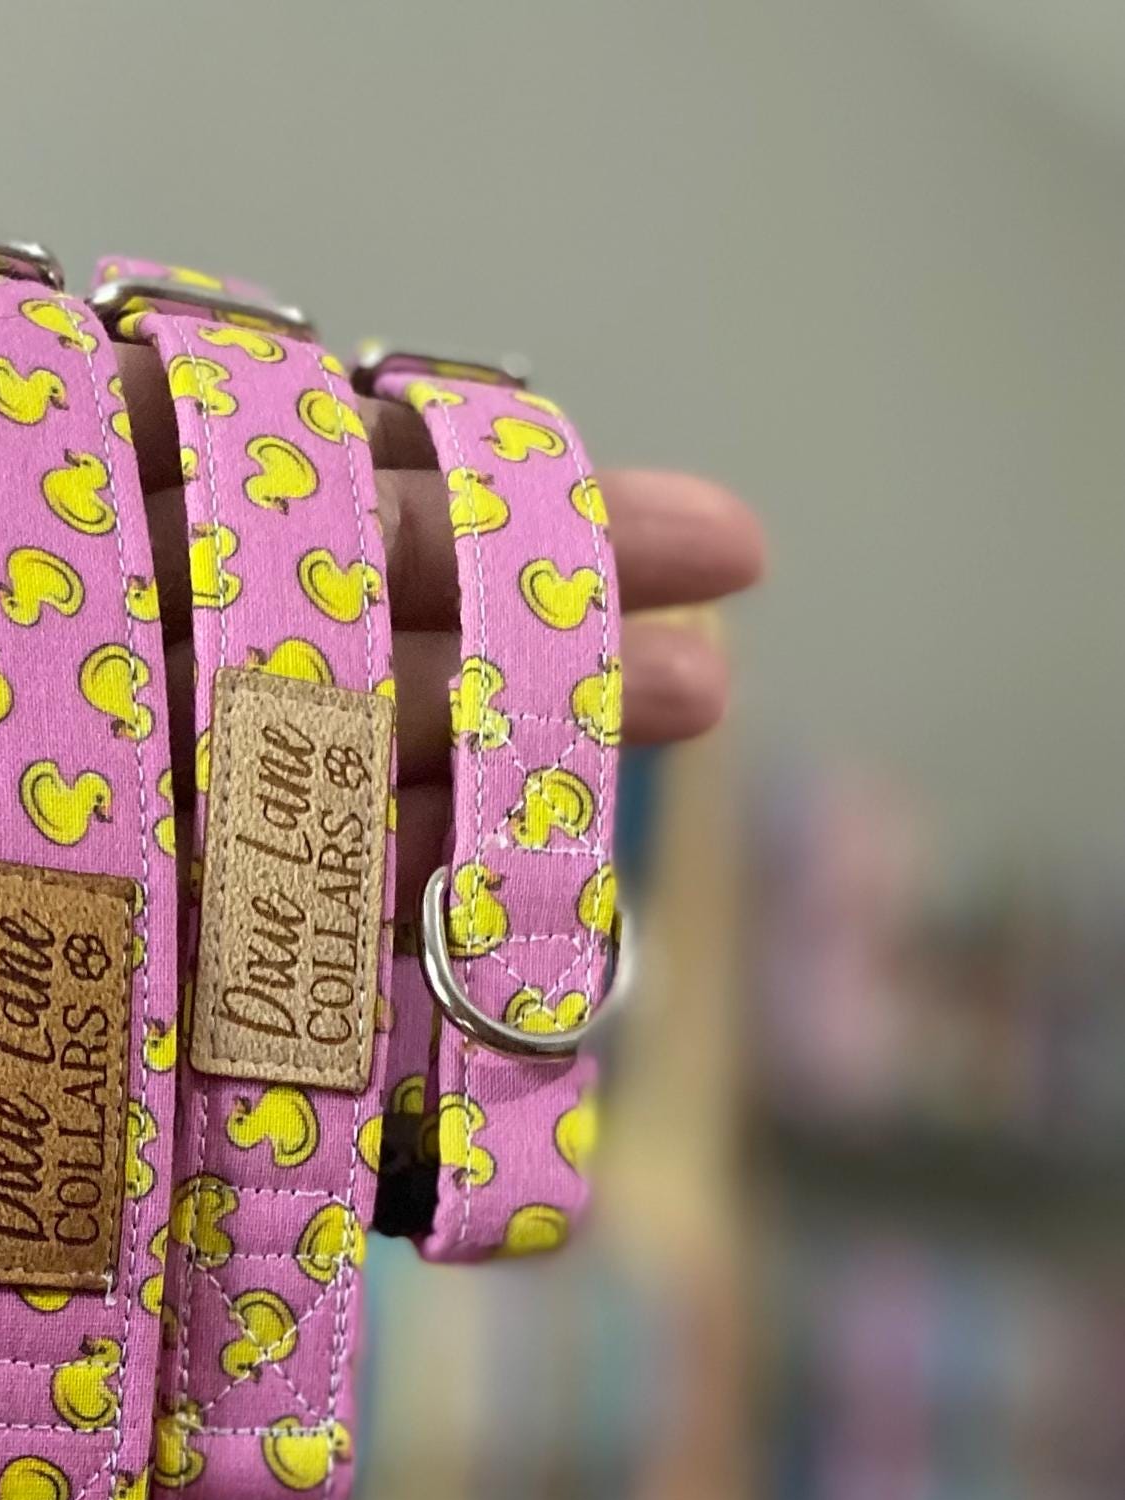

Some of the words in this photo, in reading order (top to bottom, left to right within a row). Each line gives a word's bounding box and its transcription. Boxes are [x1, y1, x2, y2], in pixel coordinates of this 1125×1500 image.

[235, 717, 316, 867] Lane
[218, 891, 306, 1040] Dixie
[306, 810, 365, 1046] COLLARS
[53, 1003, 110, 1247] COLLARS
